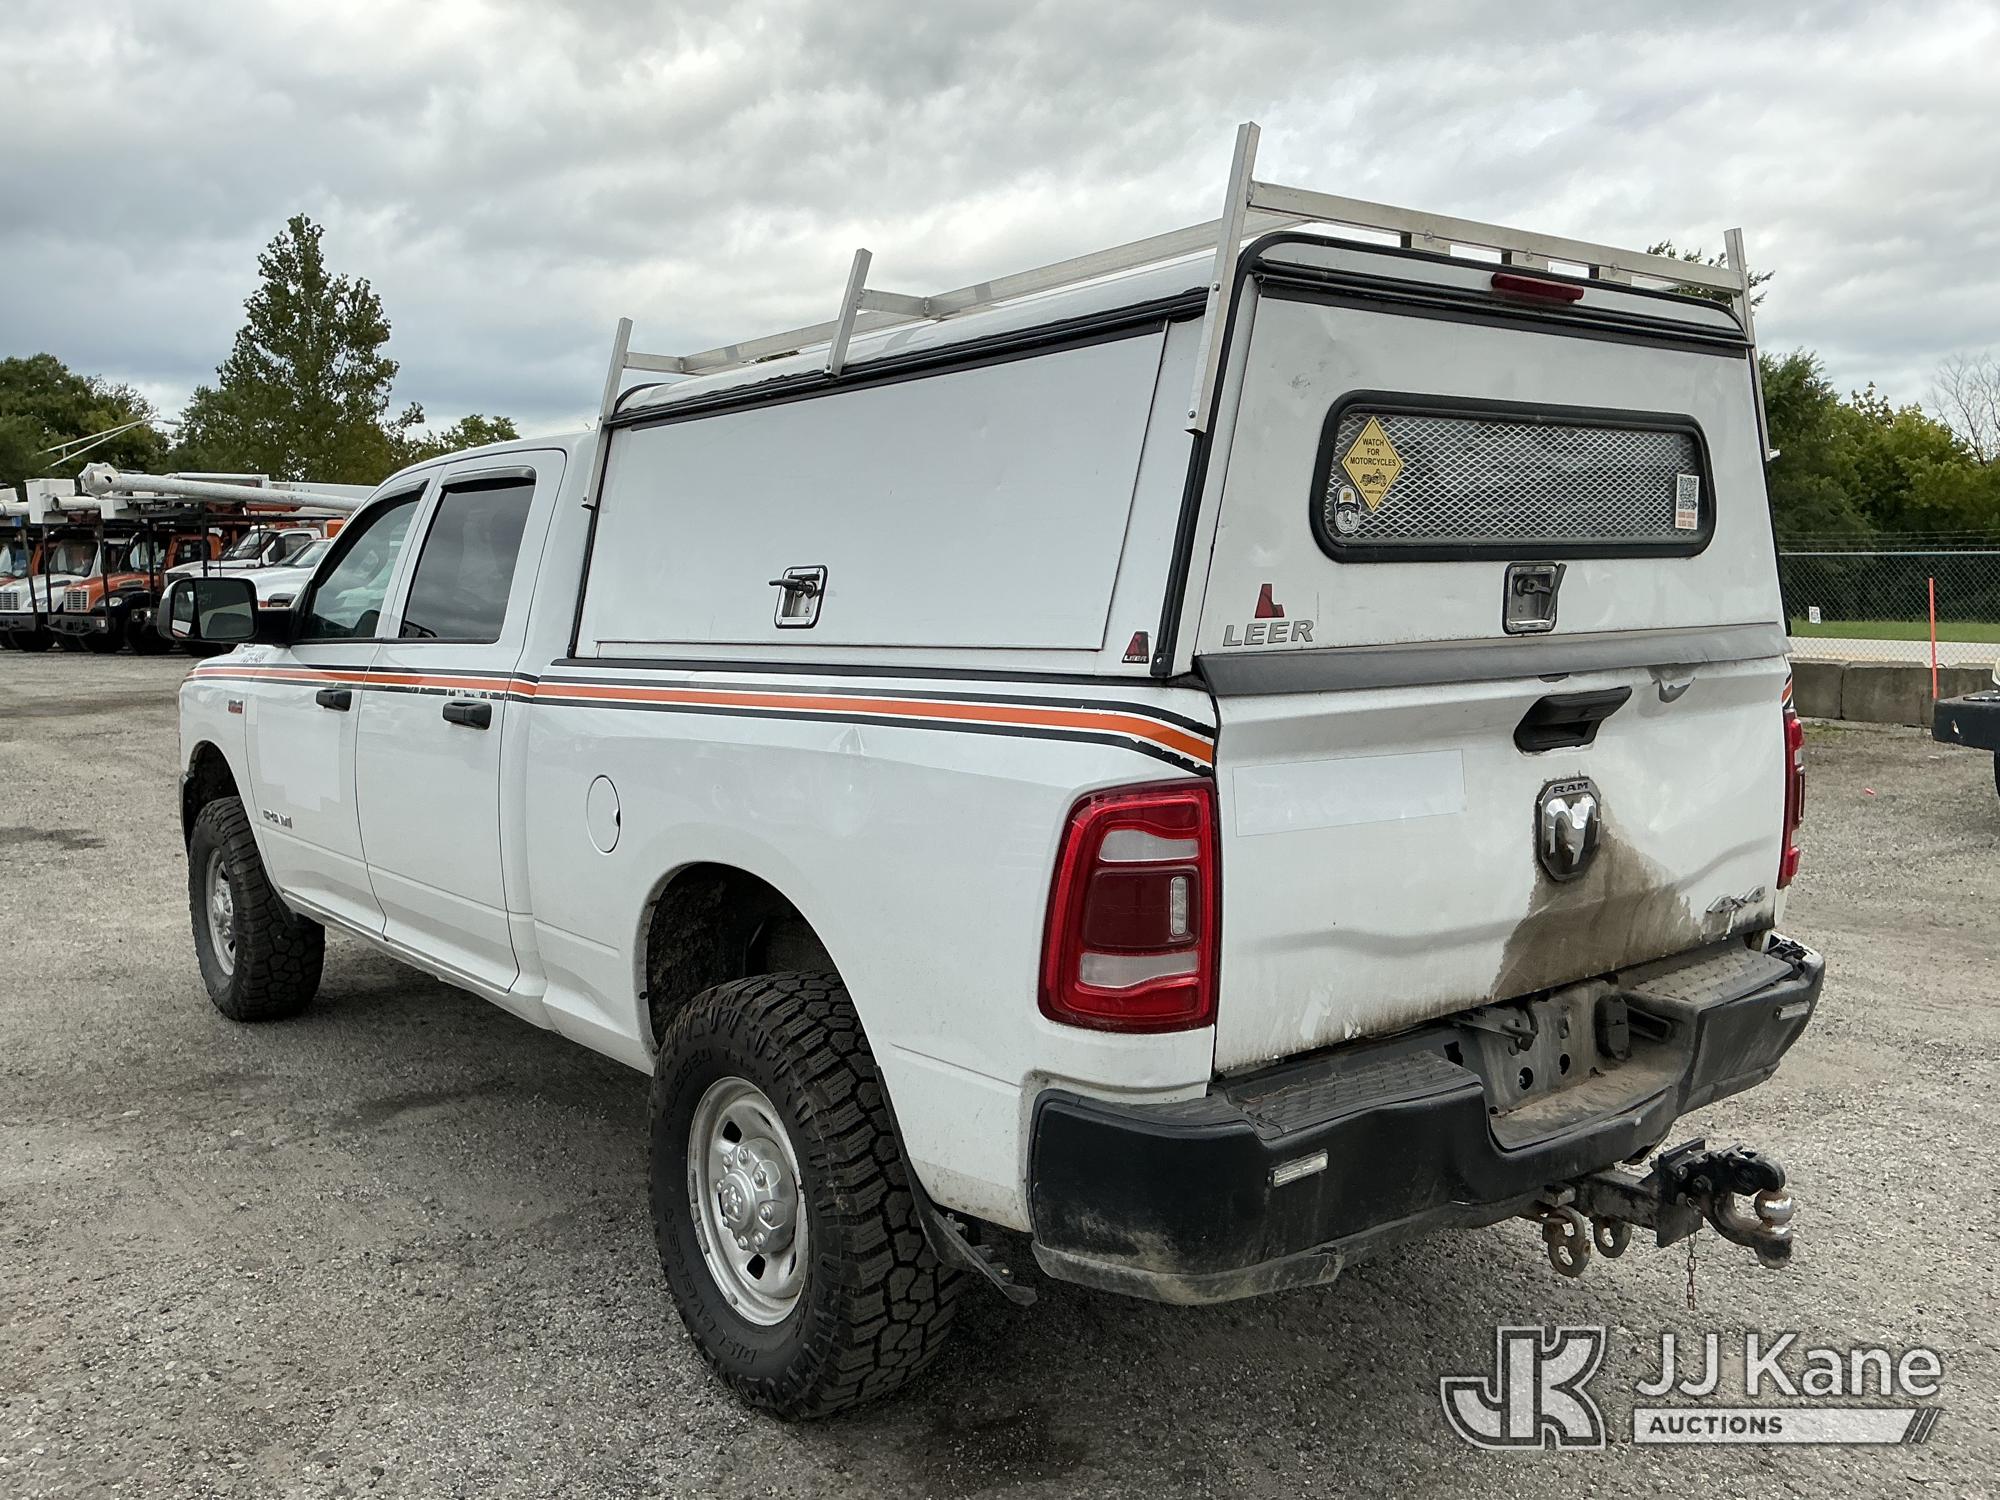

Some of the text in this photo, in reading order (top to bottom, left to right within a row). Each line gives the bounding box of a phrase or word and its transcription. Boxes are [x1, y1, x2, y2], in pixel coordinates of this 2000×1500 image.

[1362, 438, 1385, 446] WATCH
[1367, 448, 1380, 456] FOR
[1350, 457, 1397, 467] MOTORCYCLES
[1222, 619, 1315, 647] LEER
[1553, 781, 1589, 794] RAM
